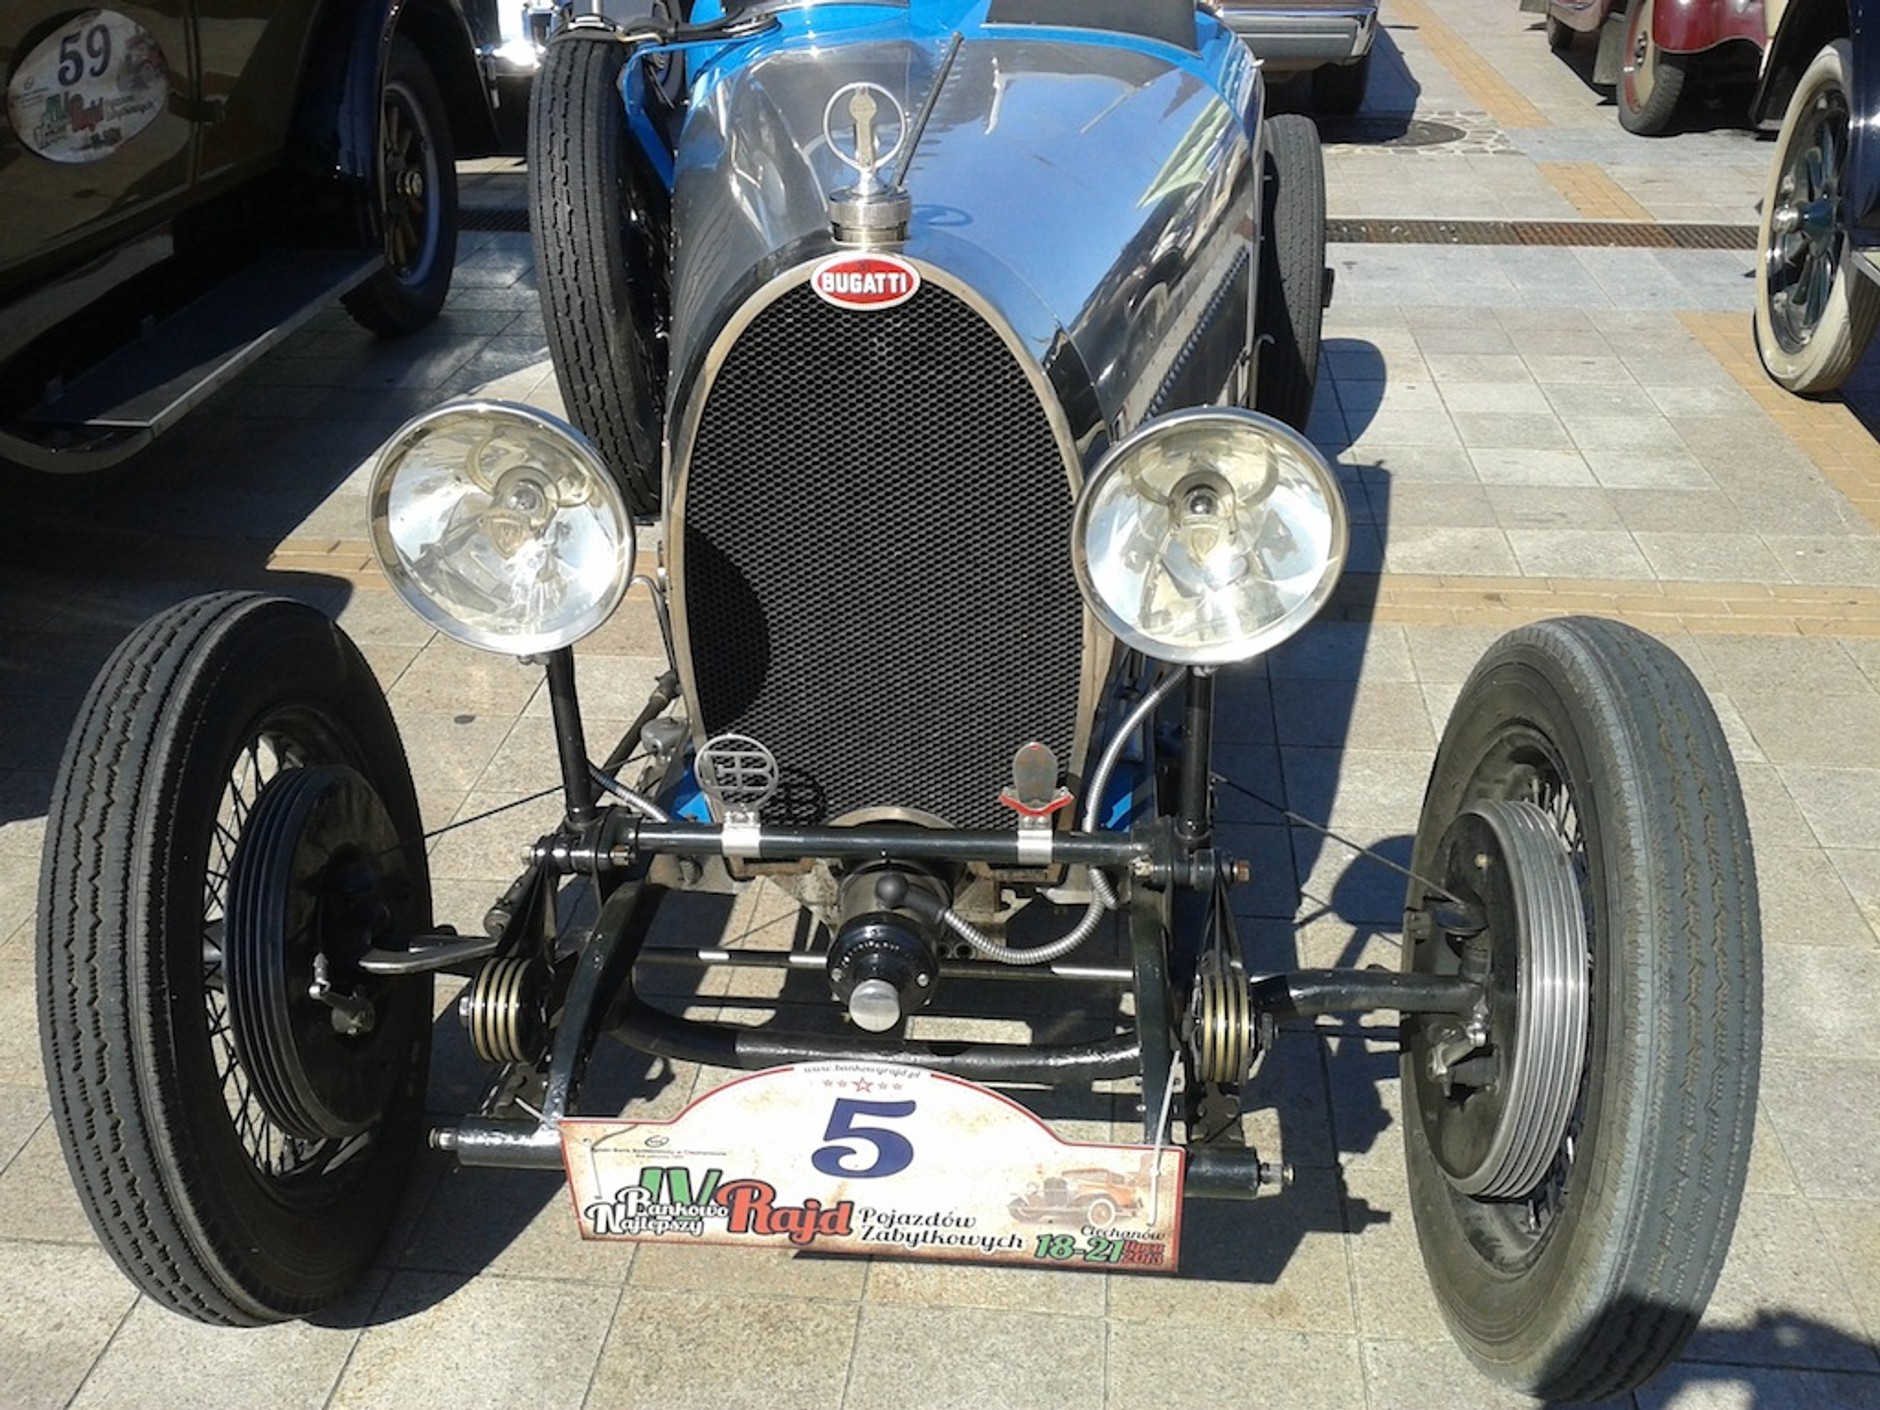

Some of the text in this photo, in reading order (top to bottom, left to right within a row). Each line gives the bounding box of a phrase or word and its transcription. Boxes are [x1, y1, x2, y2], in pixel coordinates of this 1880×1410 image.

[57, 24, 112, 87] 59
[821, 272, 907, 294] BUGATTI
[811, 1098, 917, 1178] 5
[614, 1184, 730, 1218] Bankowo
[638, 1166, 723, 1219] IV
[584, 1201, 704, 1237] Najlepszy
[715, 1179, 855, 1245] Rajd
[858, 1206, 977, 1229] Pojazdów
[861, 1224, 1024, 1251] Zabytkowych
[1034, 1233, 1125, 1264] 18-21
